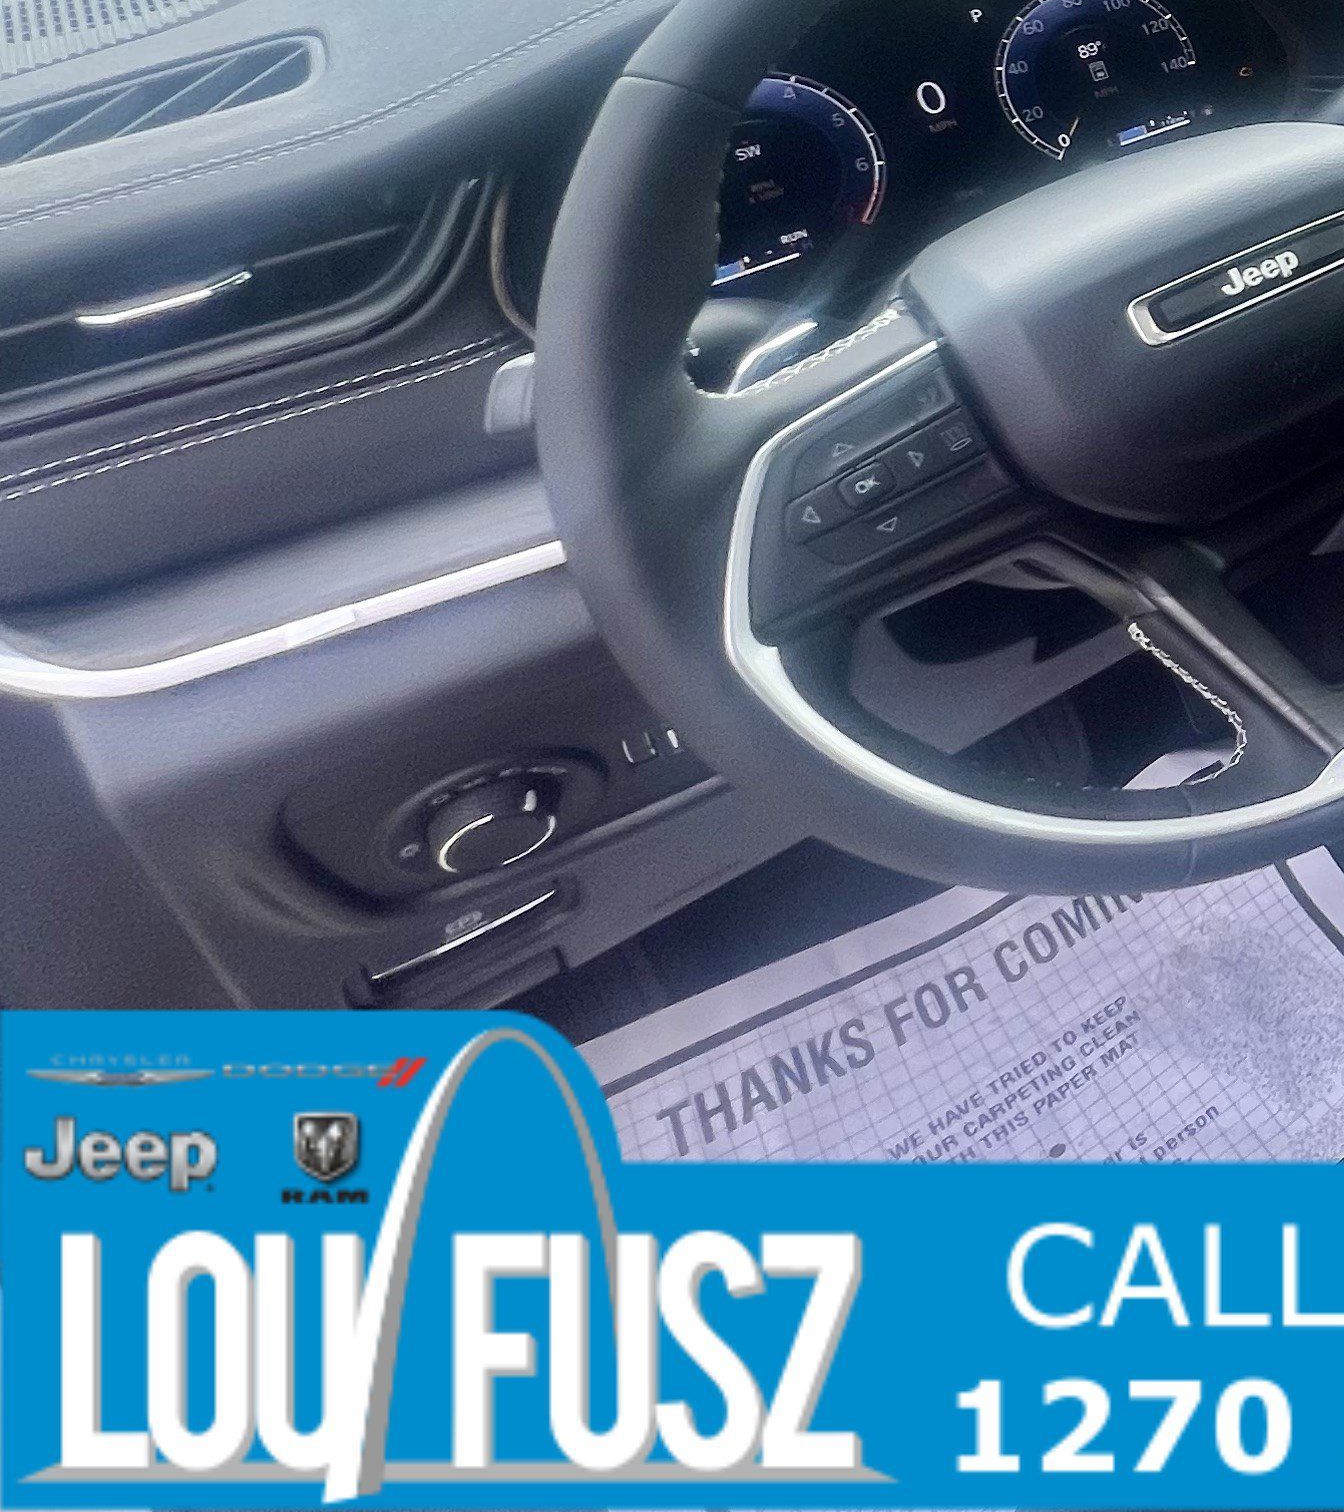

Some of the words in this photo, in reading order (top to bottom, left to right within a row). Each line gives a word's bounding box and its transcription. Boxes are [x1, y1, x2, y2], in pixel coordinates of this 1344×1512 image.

[1022, 20, 1044, 36] 60
[1141, 18, 1169, 36] 120
[1008, 60, 1028, 76] 40
[1160, 56, 1188, 74] 140
[916, 81, 946, 115] 0
[832, 112, 845, 128] 5
[1022, 106, 1044, 123] 20
[1057, 134, 1071, 148] 0
[855, 156, 869, 172] 6
[1220, 249, 1299, 297] Jeep
[855, 475, 881, 494] OK
[656, 1018, 875, 1157] THANKS
[883, 965, 989, 1046] FOR
[888, 1129, 925, 1160] WE
[928, 1090, 984, 1135] HAVE
[988, 1049, 1046, 1095] TRIED
[1050, 1029, 1077, 1054] TO
[1081, 995, 1127, 1034] KEEP
[962, 1054, 1076, 1138] CARPETING
[1079, 1009, 1142, 1057] CLEAN
[979, 1110, 1030, 1149] THIS
[1033, 1063, 1096, 1116] PAPER
[1099, 1031, 1140, 1069] MAT
[1128, 1130, 1148, 1151] is
[1153, 1106, 1219, 1161] person
